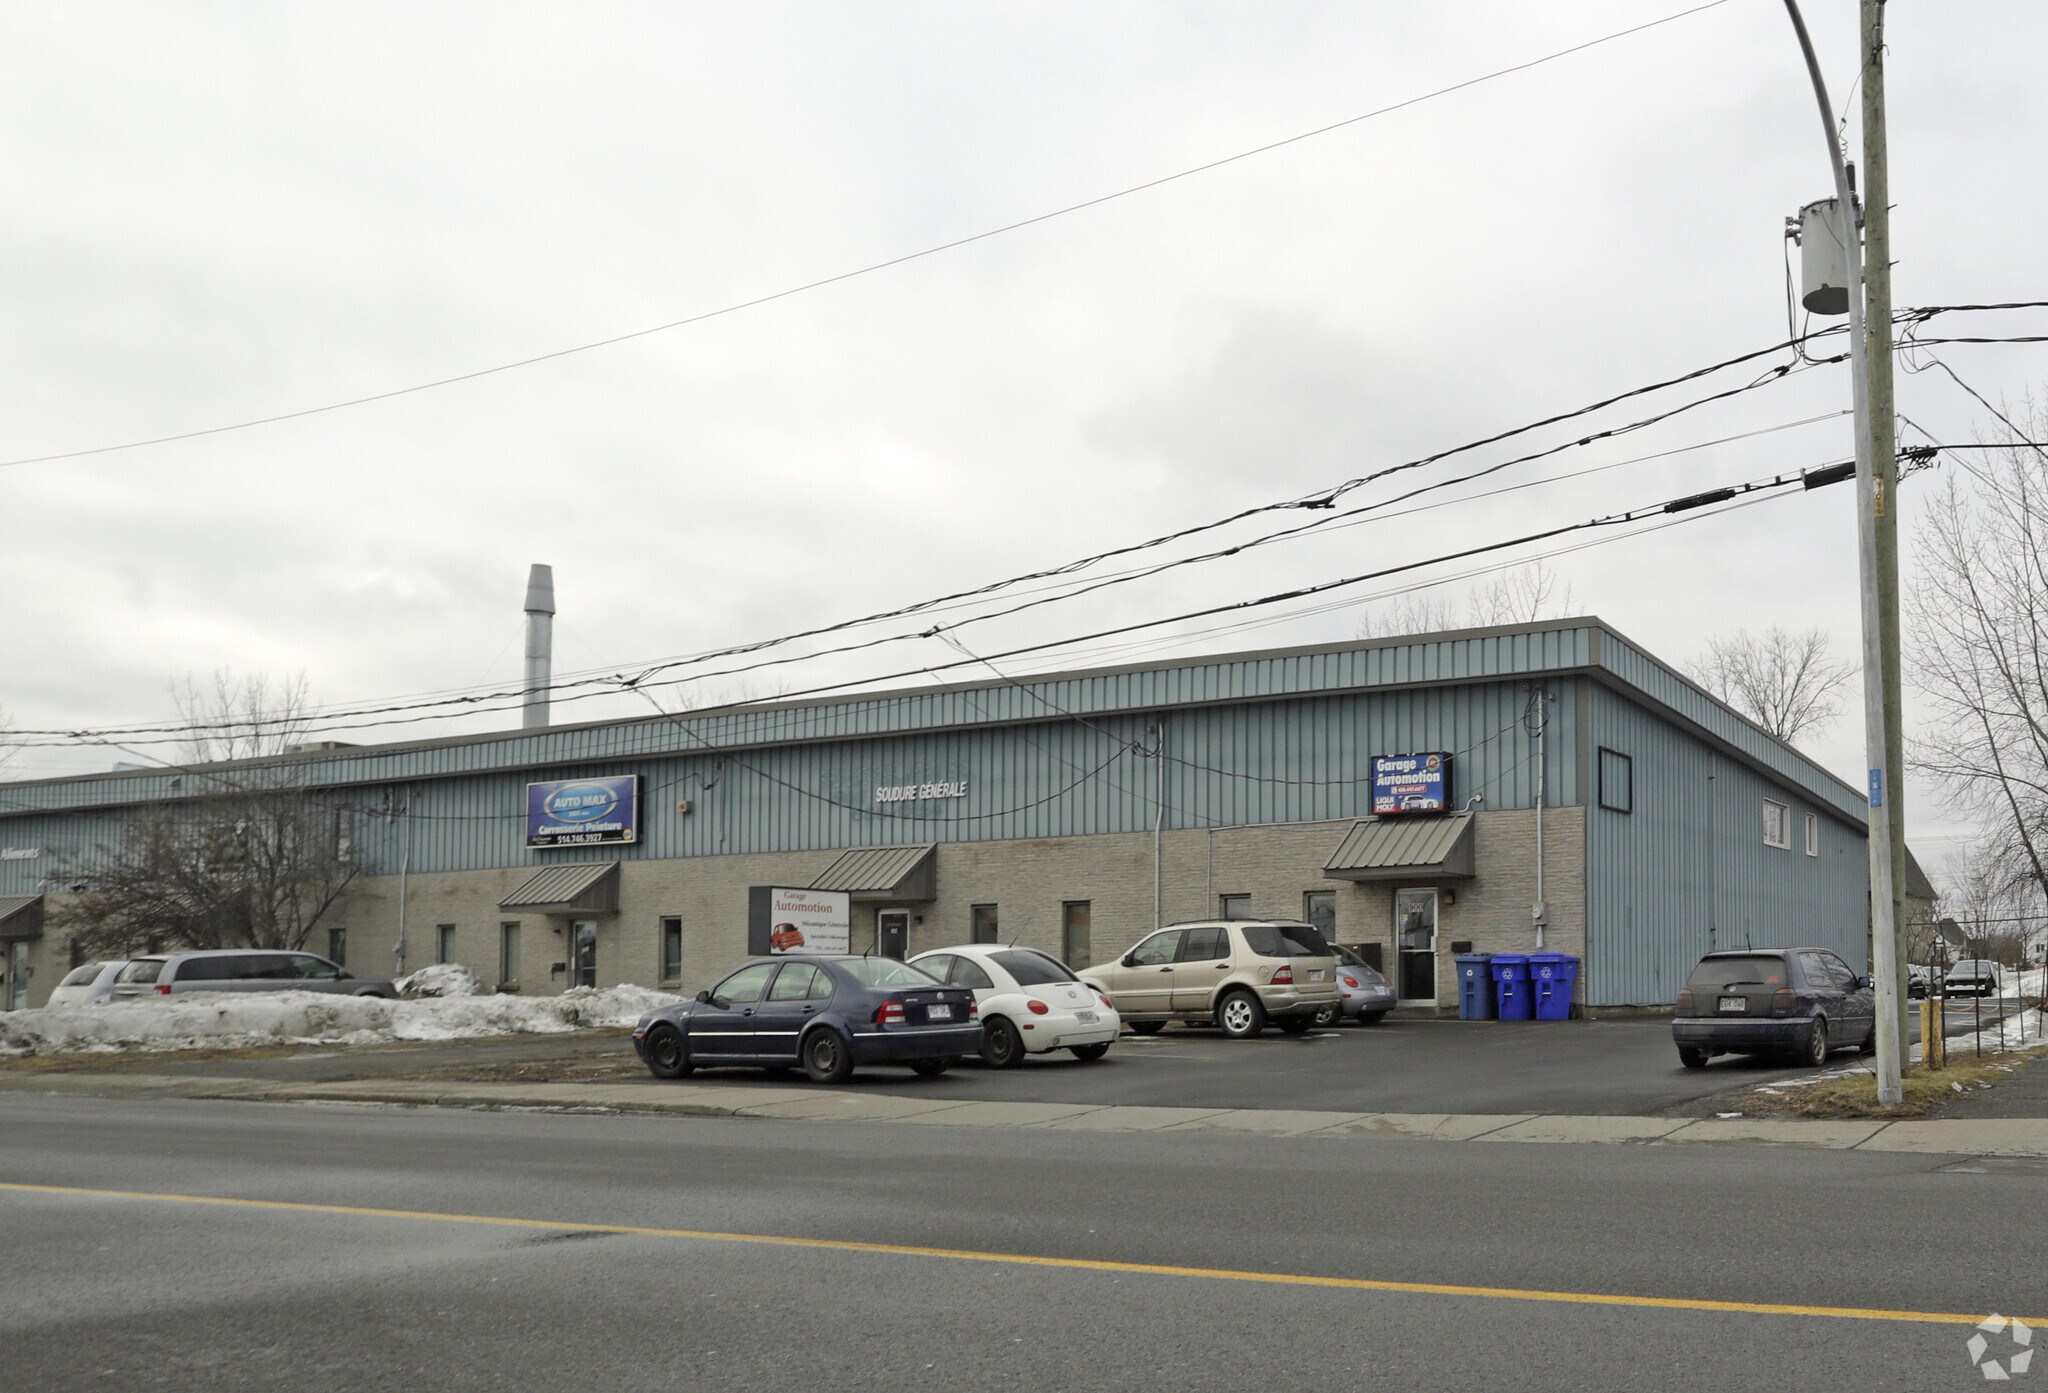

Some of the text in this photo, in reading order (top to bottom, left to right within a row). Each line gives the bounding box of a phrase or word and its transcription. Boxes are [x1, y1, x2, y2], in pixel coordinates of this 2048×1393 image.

[1377, 758, 1417, 772] Garage
[1376, 769, 1440, 786] Automotion
[876, 780, 967, 802] SOUDURE GÉNÉRALE
[554, 794, 607, 808] AUTO MAX
[538, 822, 622, 835] Carrosserie Peinture
[784, 891, 807, 901] Garage
[774, 900, 833, 913] Automotion
